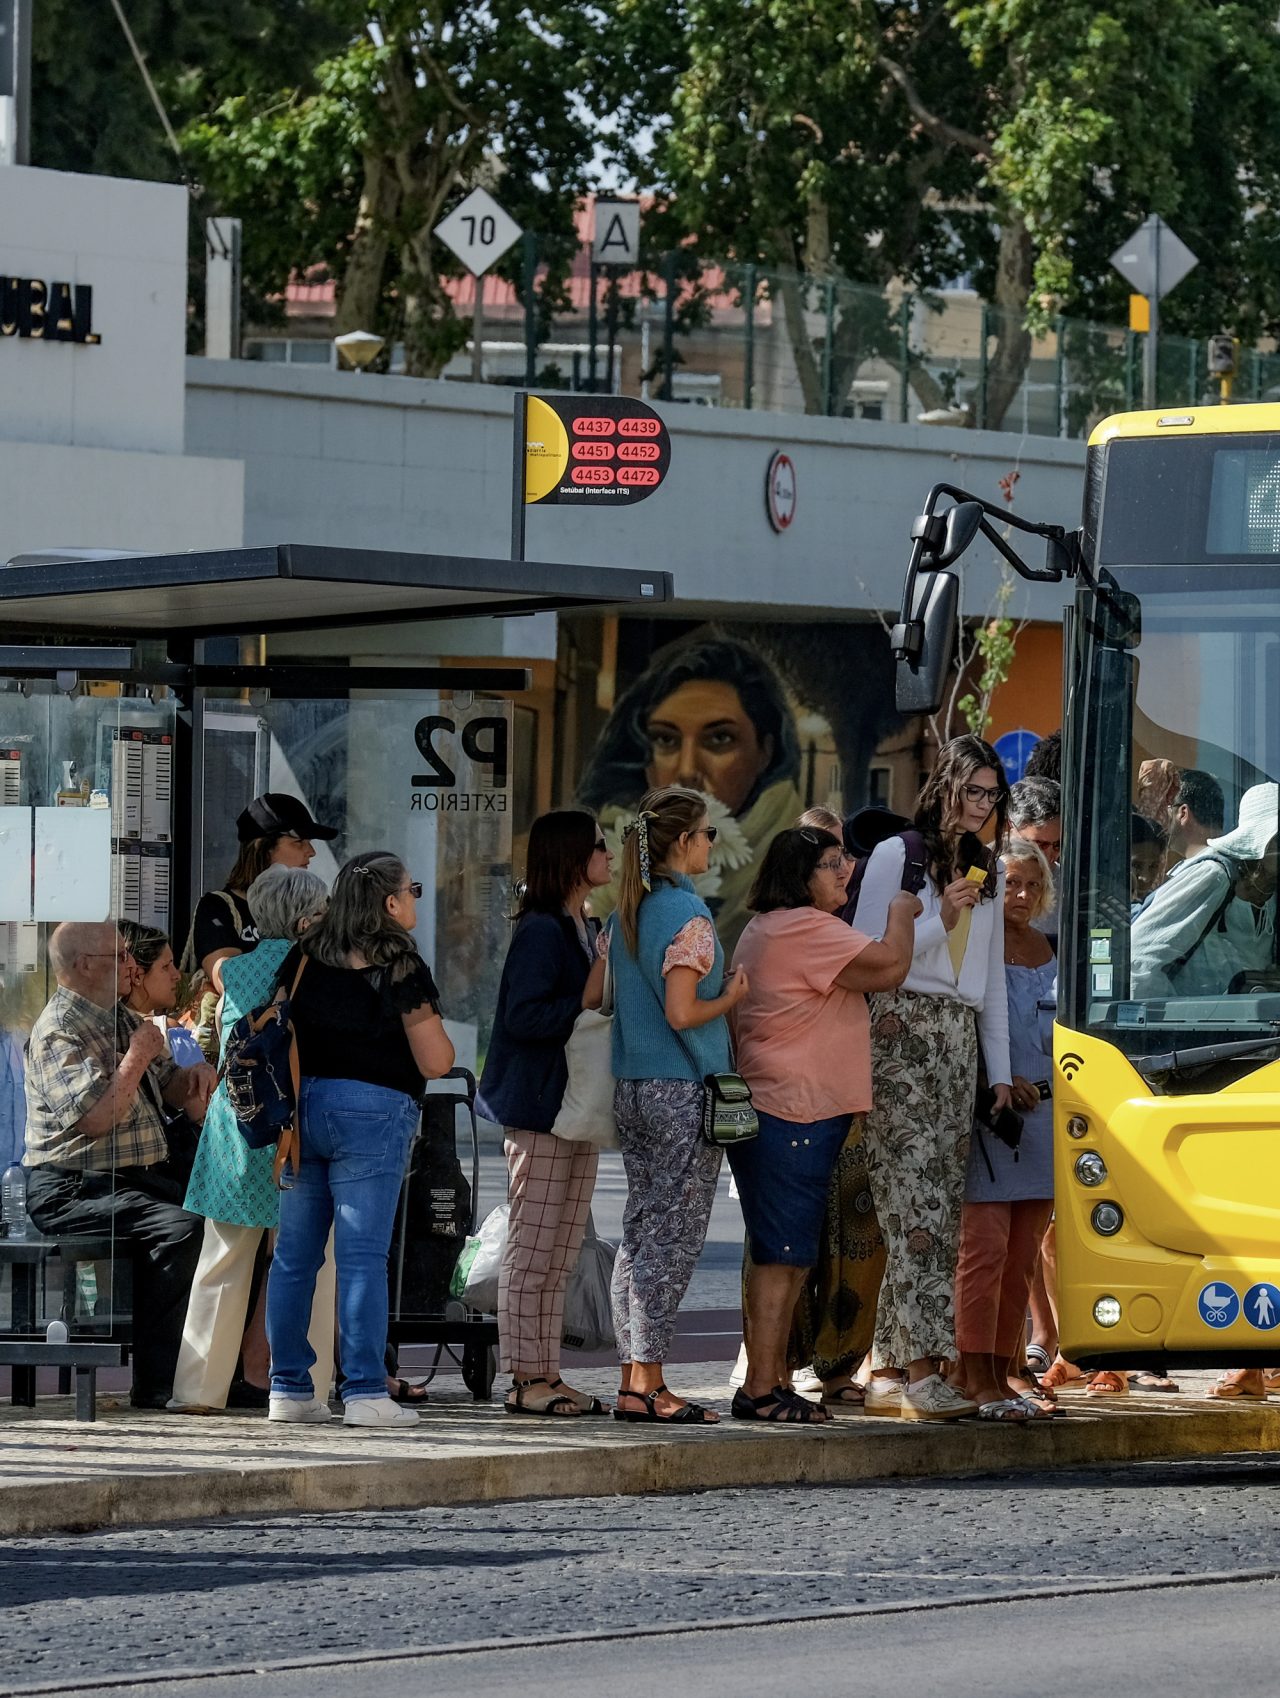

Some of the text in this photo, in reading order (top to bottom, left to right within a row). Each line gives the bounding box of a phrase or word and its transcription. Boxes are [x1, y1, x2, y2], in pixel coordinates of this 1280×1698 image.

[461, 215, 495, 246] 70
[601, 213, 630, 253] A
[577, 421, 656, 433] 4437 4439
[578, 445, 655, 458] 4451 4452
[576, 469, 654, 482] 4453 4472
[560, 486, 630, 495] Setúbal (Interface ITS)
